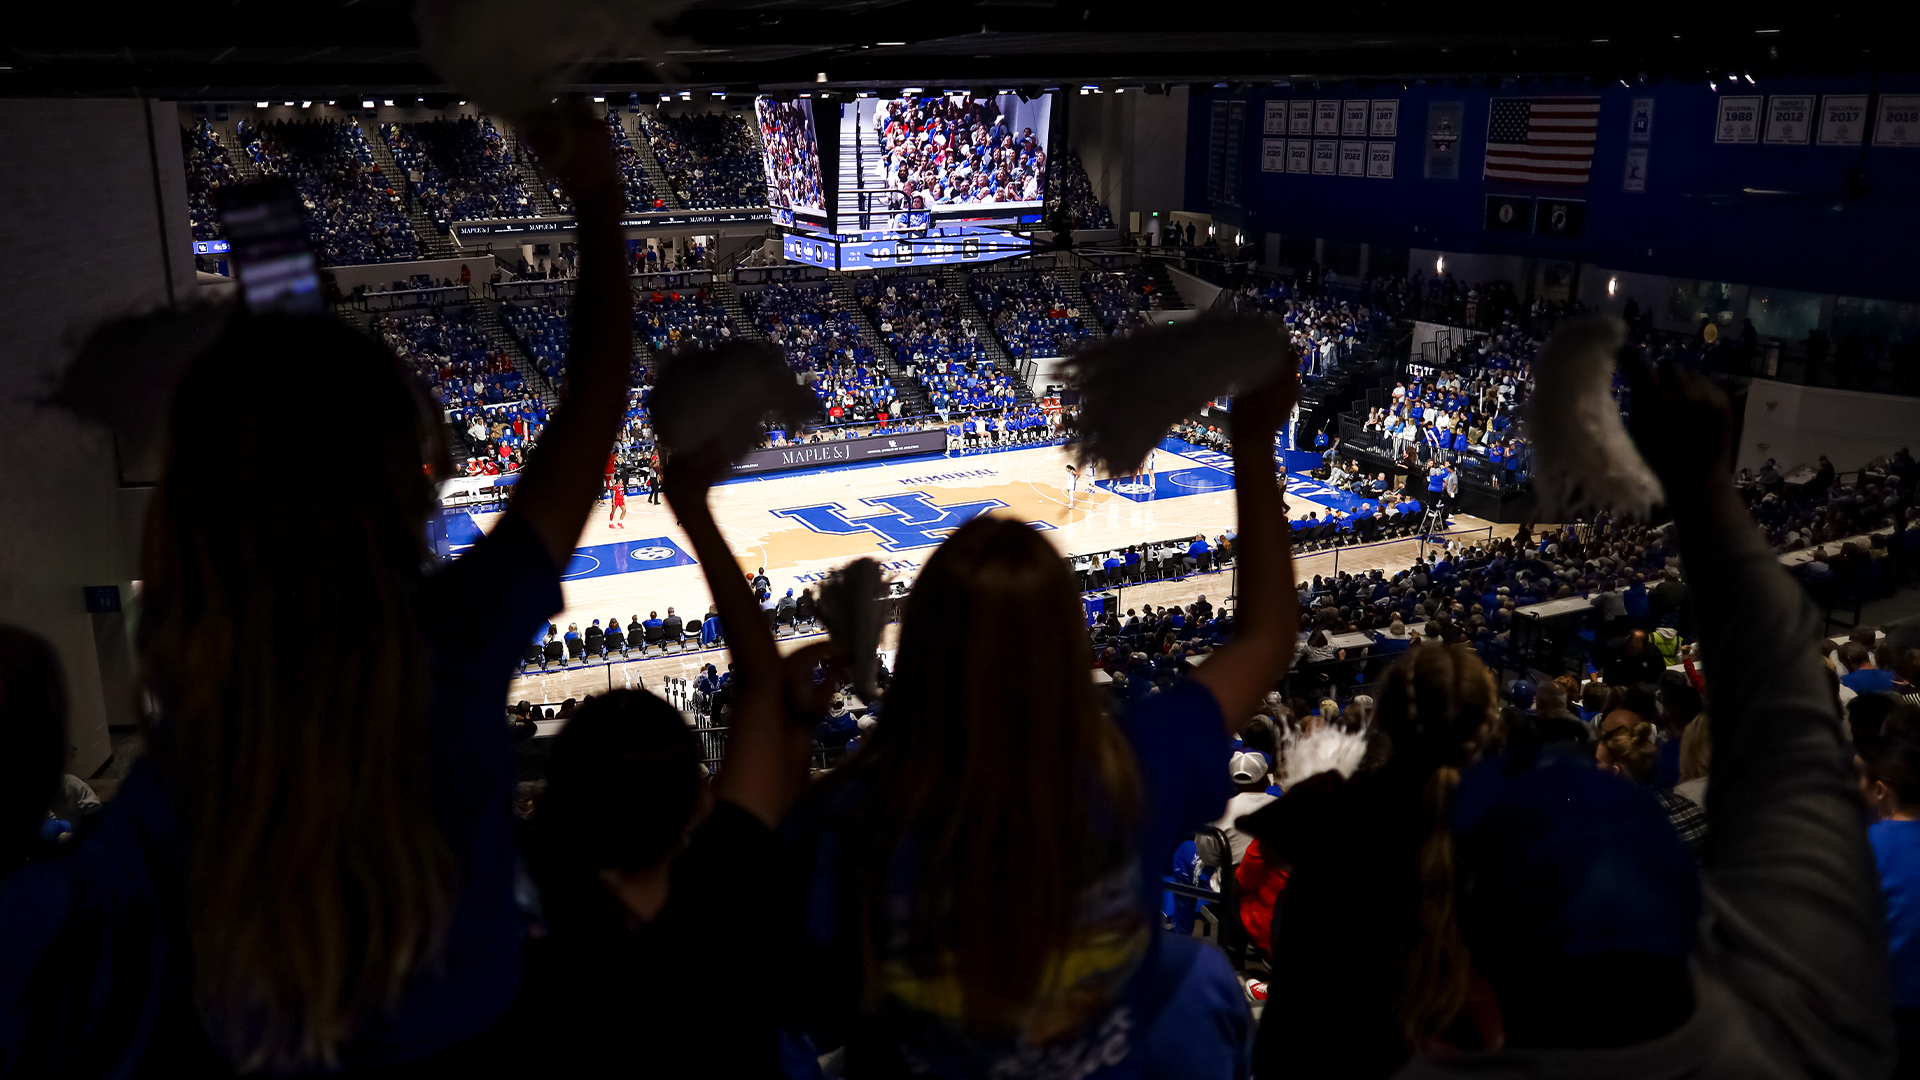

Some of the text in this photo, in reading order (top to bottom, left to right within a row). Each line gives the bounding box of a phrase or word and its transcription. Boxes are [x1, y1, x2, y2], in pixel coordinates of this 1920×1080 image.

[1725, 113, 1752, 121] 1988
[1775, 112, 1803, 121] 2012
[1830, 112, 1859, 122] 2017
[1886, 112, 1919, 122] 2018
[782, 444, 850, 465] MAPLE & J
[897, 469, 999, 484] MEMORIAL
